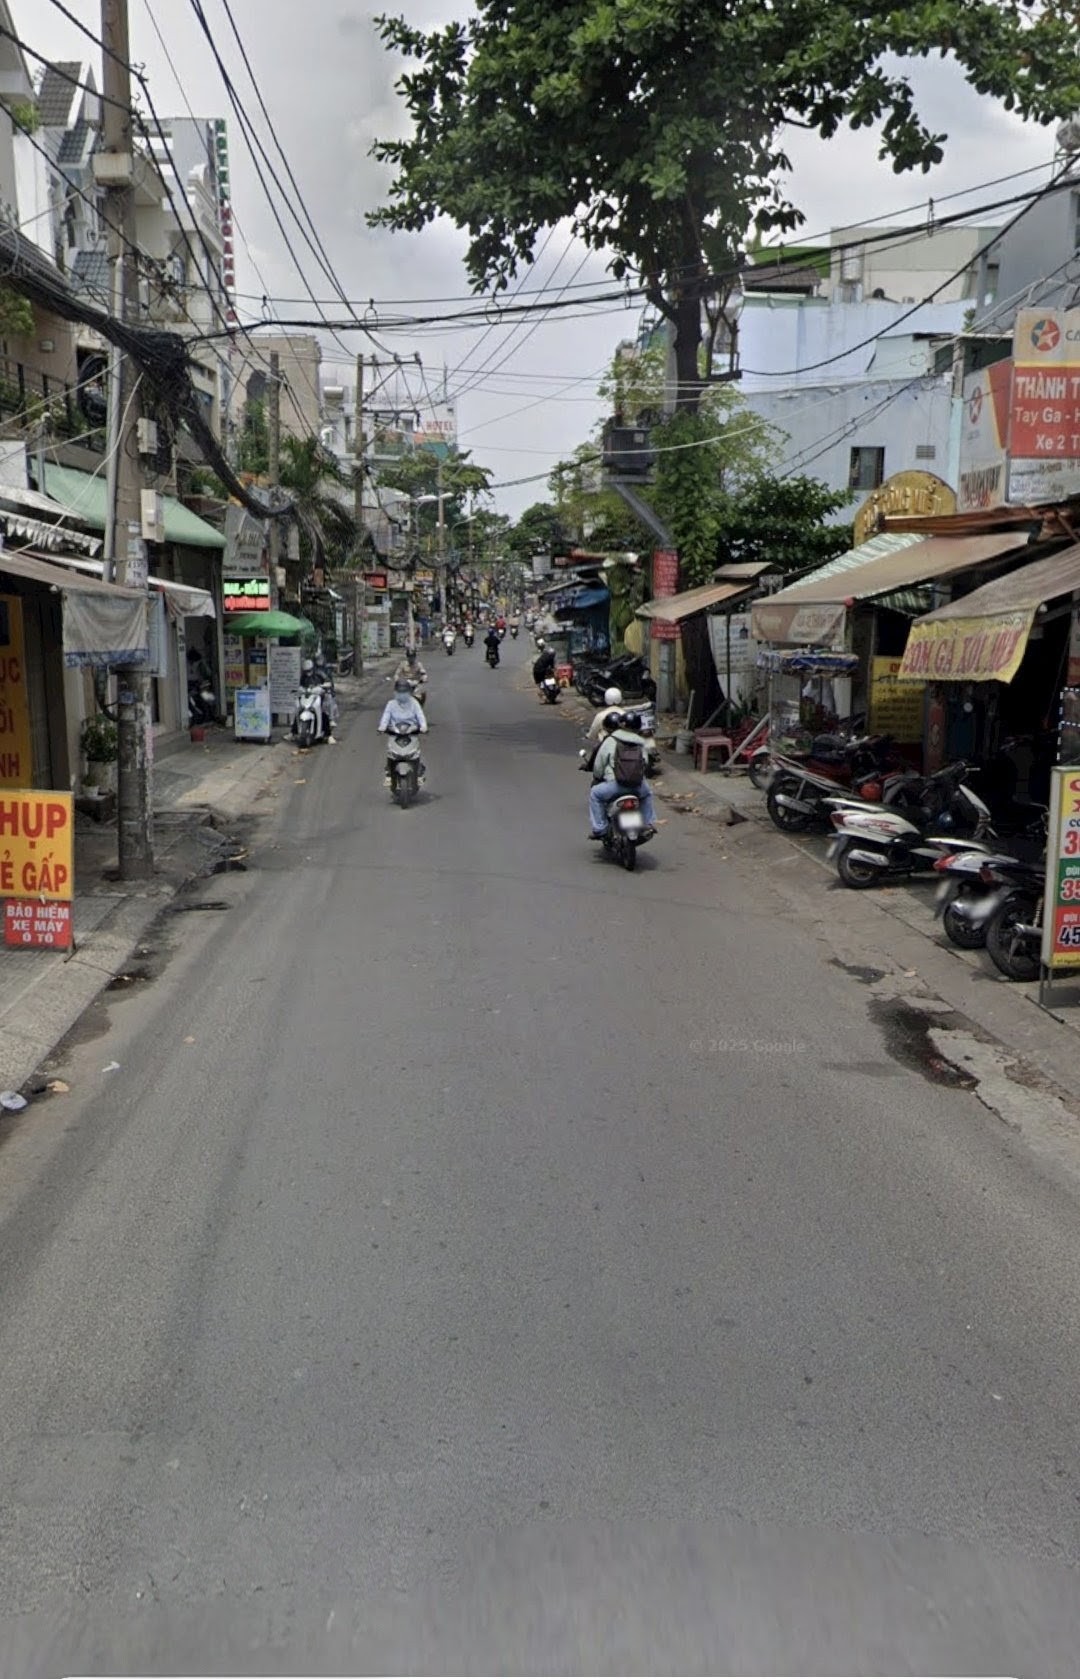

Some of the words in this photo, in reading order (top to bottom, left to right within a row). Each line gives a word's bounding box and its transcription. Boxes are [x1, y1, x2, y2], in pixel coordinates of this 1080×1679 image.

[1015, 371, 1067, 399] THÀNH
[1014, 406, 1039, 427] Tay
[1042, 406, 1062, 423] Ga
[1035, 434, 1054, 450] Xe
[1057, 434, 1065, 450] 2
[0, 801, 67, 849] HỤP
[1065, 830, 1080, 854] 3
[22, 851, 68, 892] GẤP
[6, 902, 33, 918] BẢO
[36, 902, 70, 919] HIỂM
[12, 920, 30, 931] XE
[34, 919, 64, 933] MÁY
